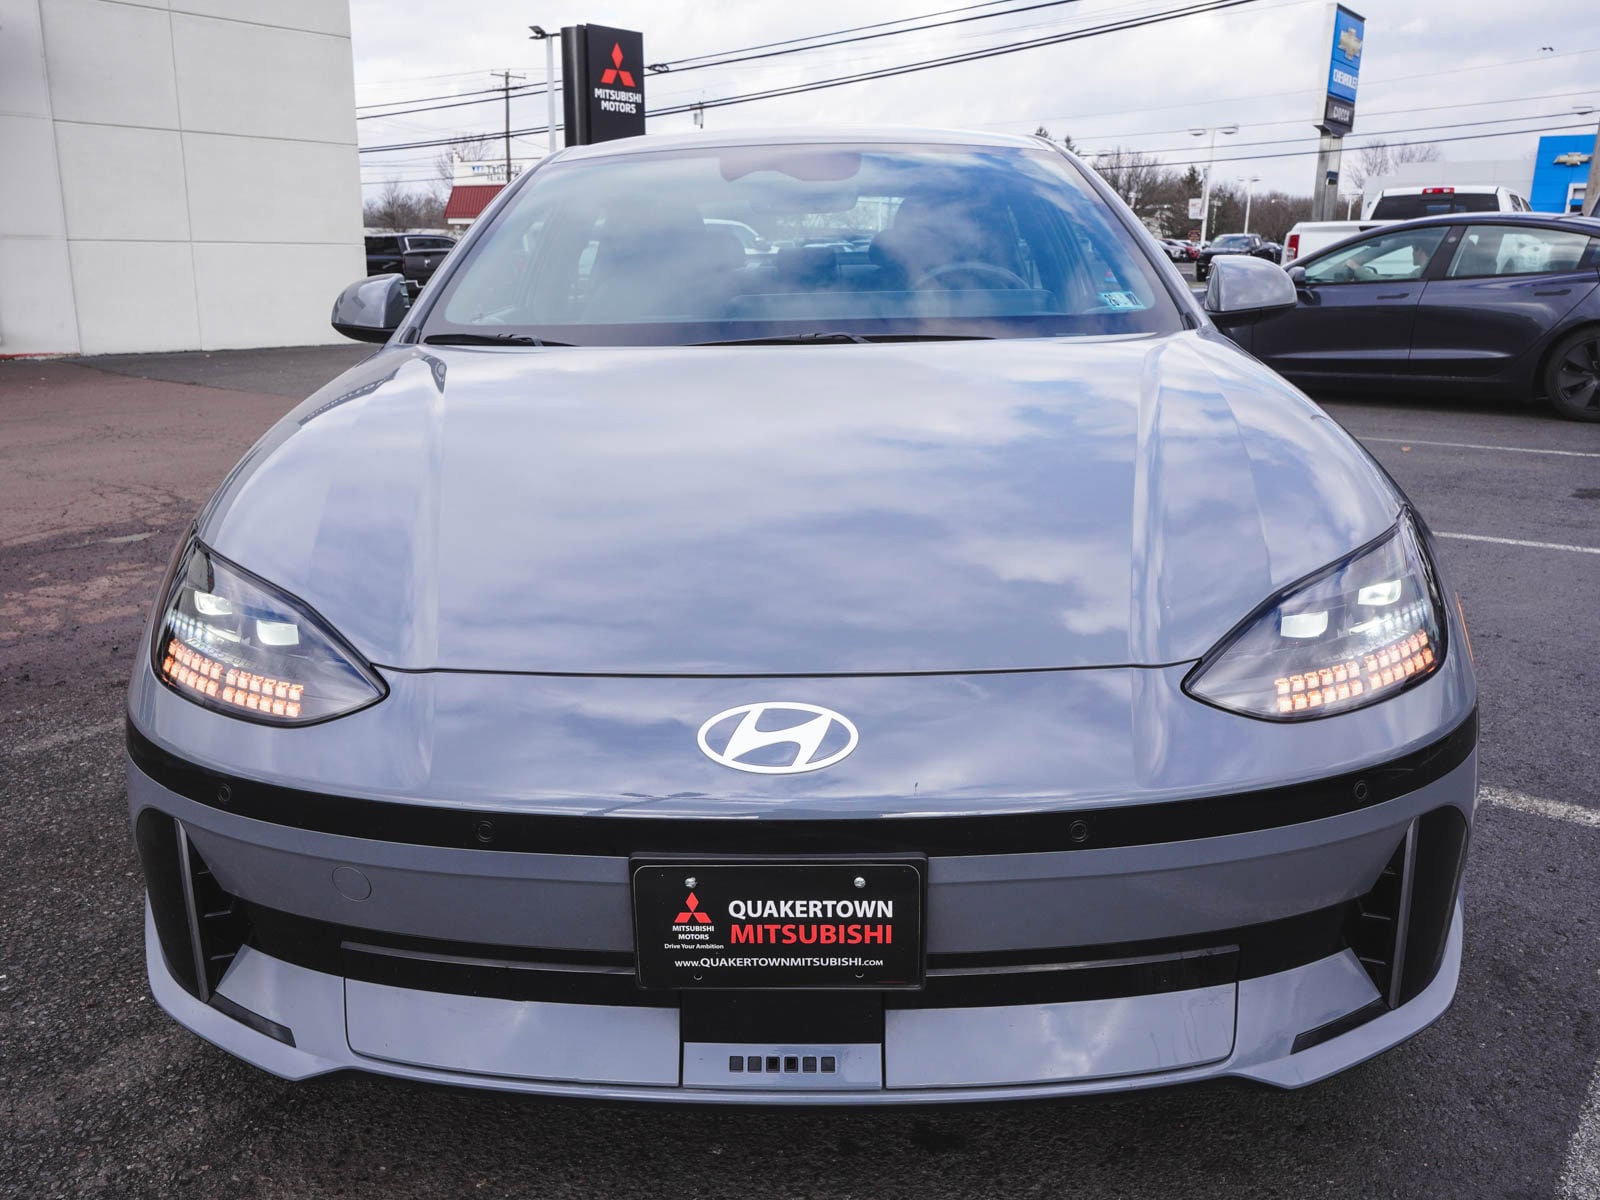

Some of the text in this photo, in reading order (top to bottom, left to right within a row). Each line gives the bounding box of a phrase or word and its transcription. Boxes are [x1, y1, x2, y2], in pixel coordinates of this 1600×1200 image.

[594, 88, 642, 103] MITSUBISHI
[601, 101, 637, 114] MOTORS
[728, 900, 893, 919] QUAKERTOWN
[730, 924, 892, 944] MITSUBISHI
